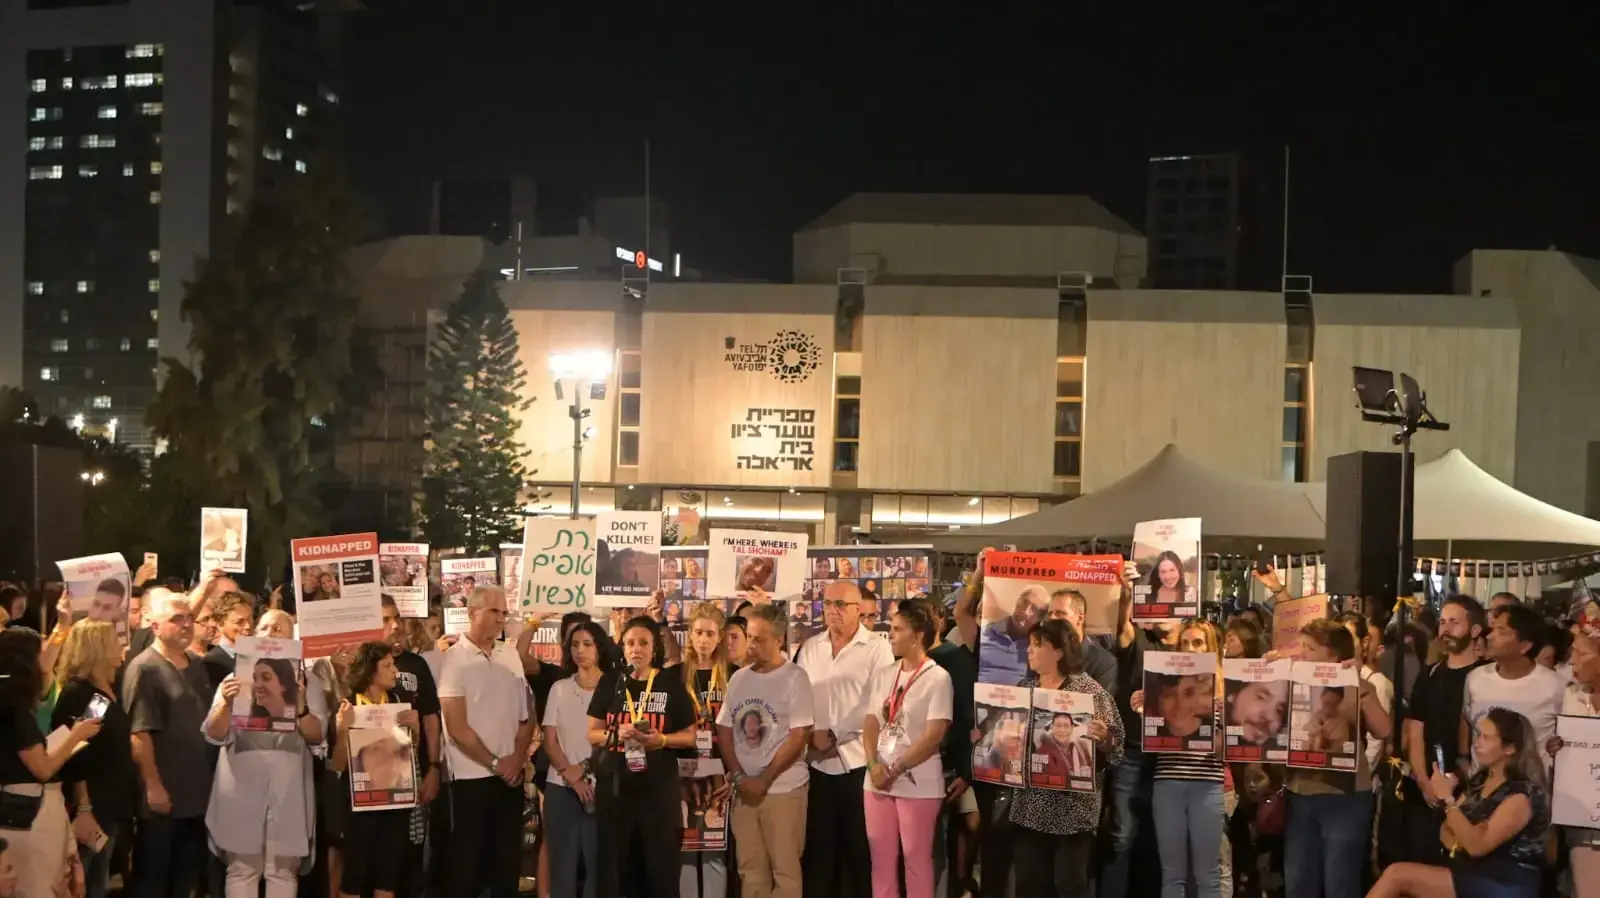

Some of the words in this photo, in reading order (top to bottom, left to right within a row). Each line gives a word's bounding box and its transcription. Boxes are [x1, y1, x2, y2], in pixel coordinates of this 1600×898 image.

[739, 345, 754, 353] TEL
[725, 354, 745, 362] AVIV
[733, 363, 754, 371] YAFO
[746, 408, 815, 422] ספריית
[779, 441, 814, 454] בית
[737, 455, 813, 470] אריאלה
[611, 521, 648, 531] DON'T
[541, 529, 595, 551] רת
[723, 537, 735, 545] I'M
[760, 540, 789, 549] WHERE
[299, 541, 372, 556] KIDNAPPED
[388, 545, 419, 553] KIDNAPPED
[748, 546, 788, 556] SHOHAM?
[451, 561, 486, 569] KIDNAPPED
[990, 565, 1057, 577] MURDERED
[1064, 570, 1117, 582] KIDNAPPED
[522, 579, 586, 608] עכשיו!
